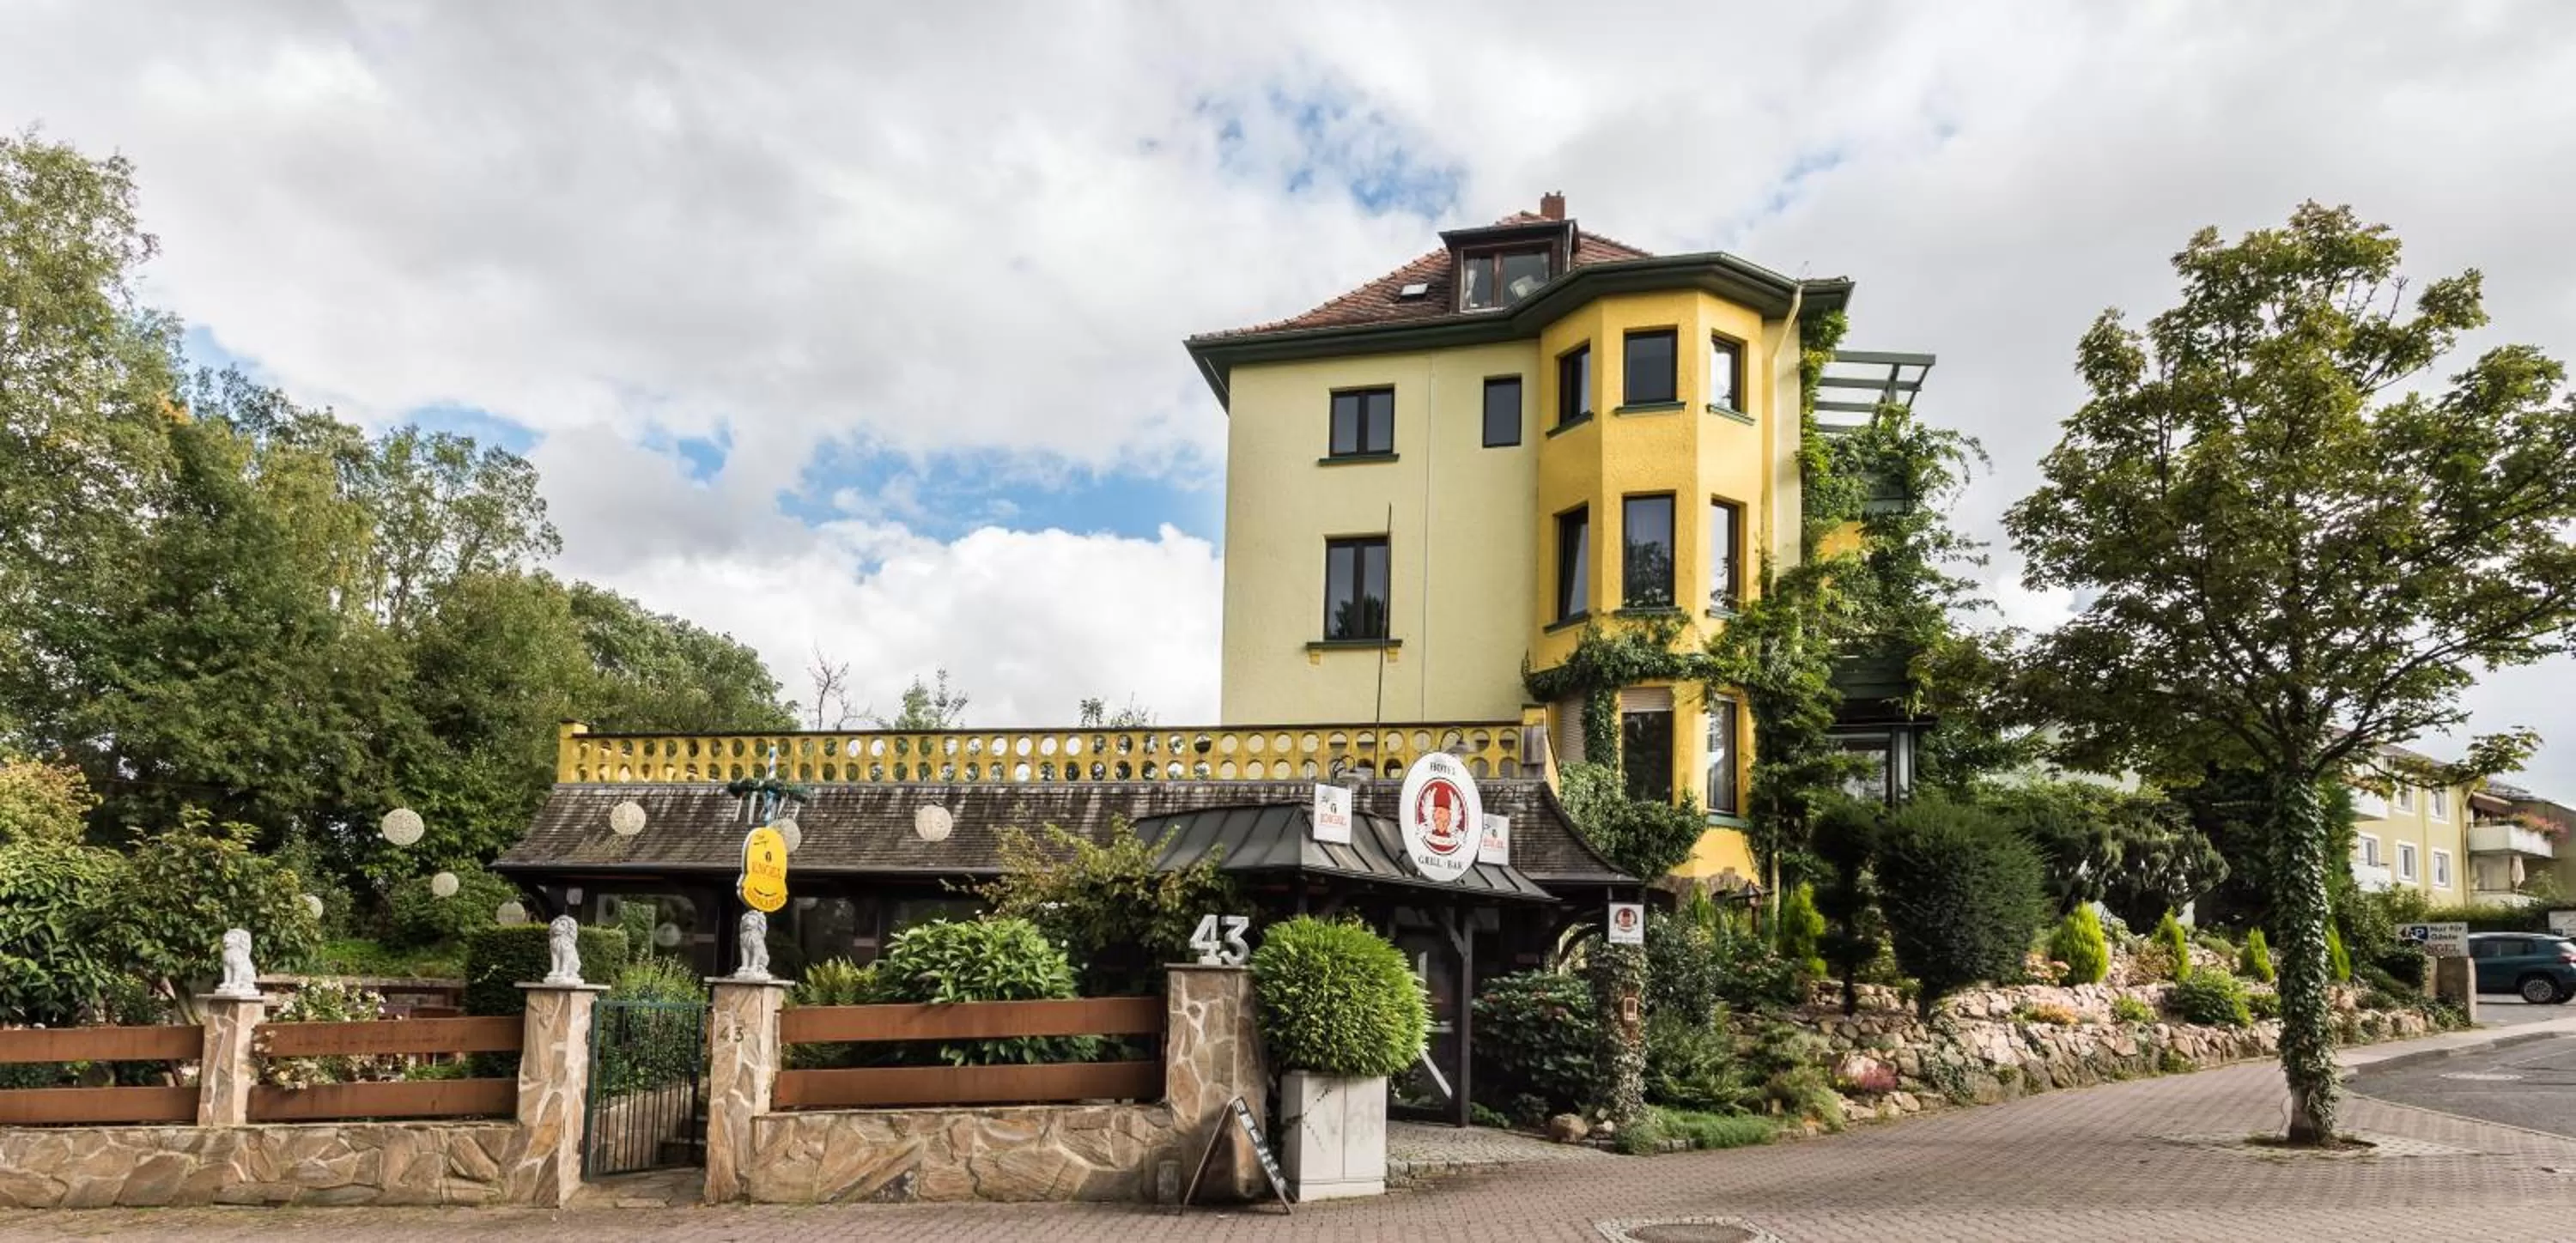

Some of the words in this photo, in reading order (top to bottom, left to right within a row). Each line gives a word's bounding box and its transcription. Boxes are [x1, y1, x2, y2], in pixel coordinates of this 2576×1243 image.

[1430, 761, 1456, 776] HOTEL
[752, 861, 782, 880] ENGEL
[1418, 855, 1443, 868] GRILL
[1448, 858, 1464, 870] BAR
[1188, 914, 1250, 966] 43
